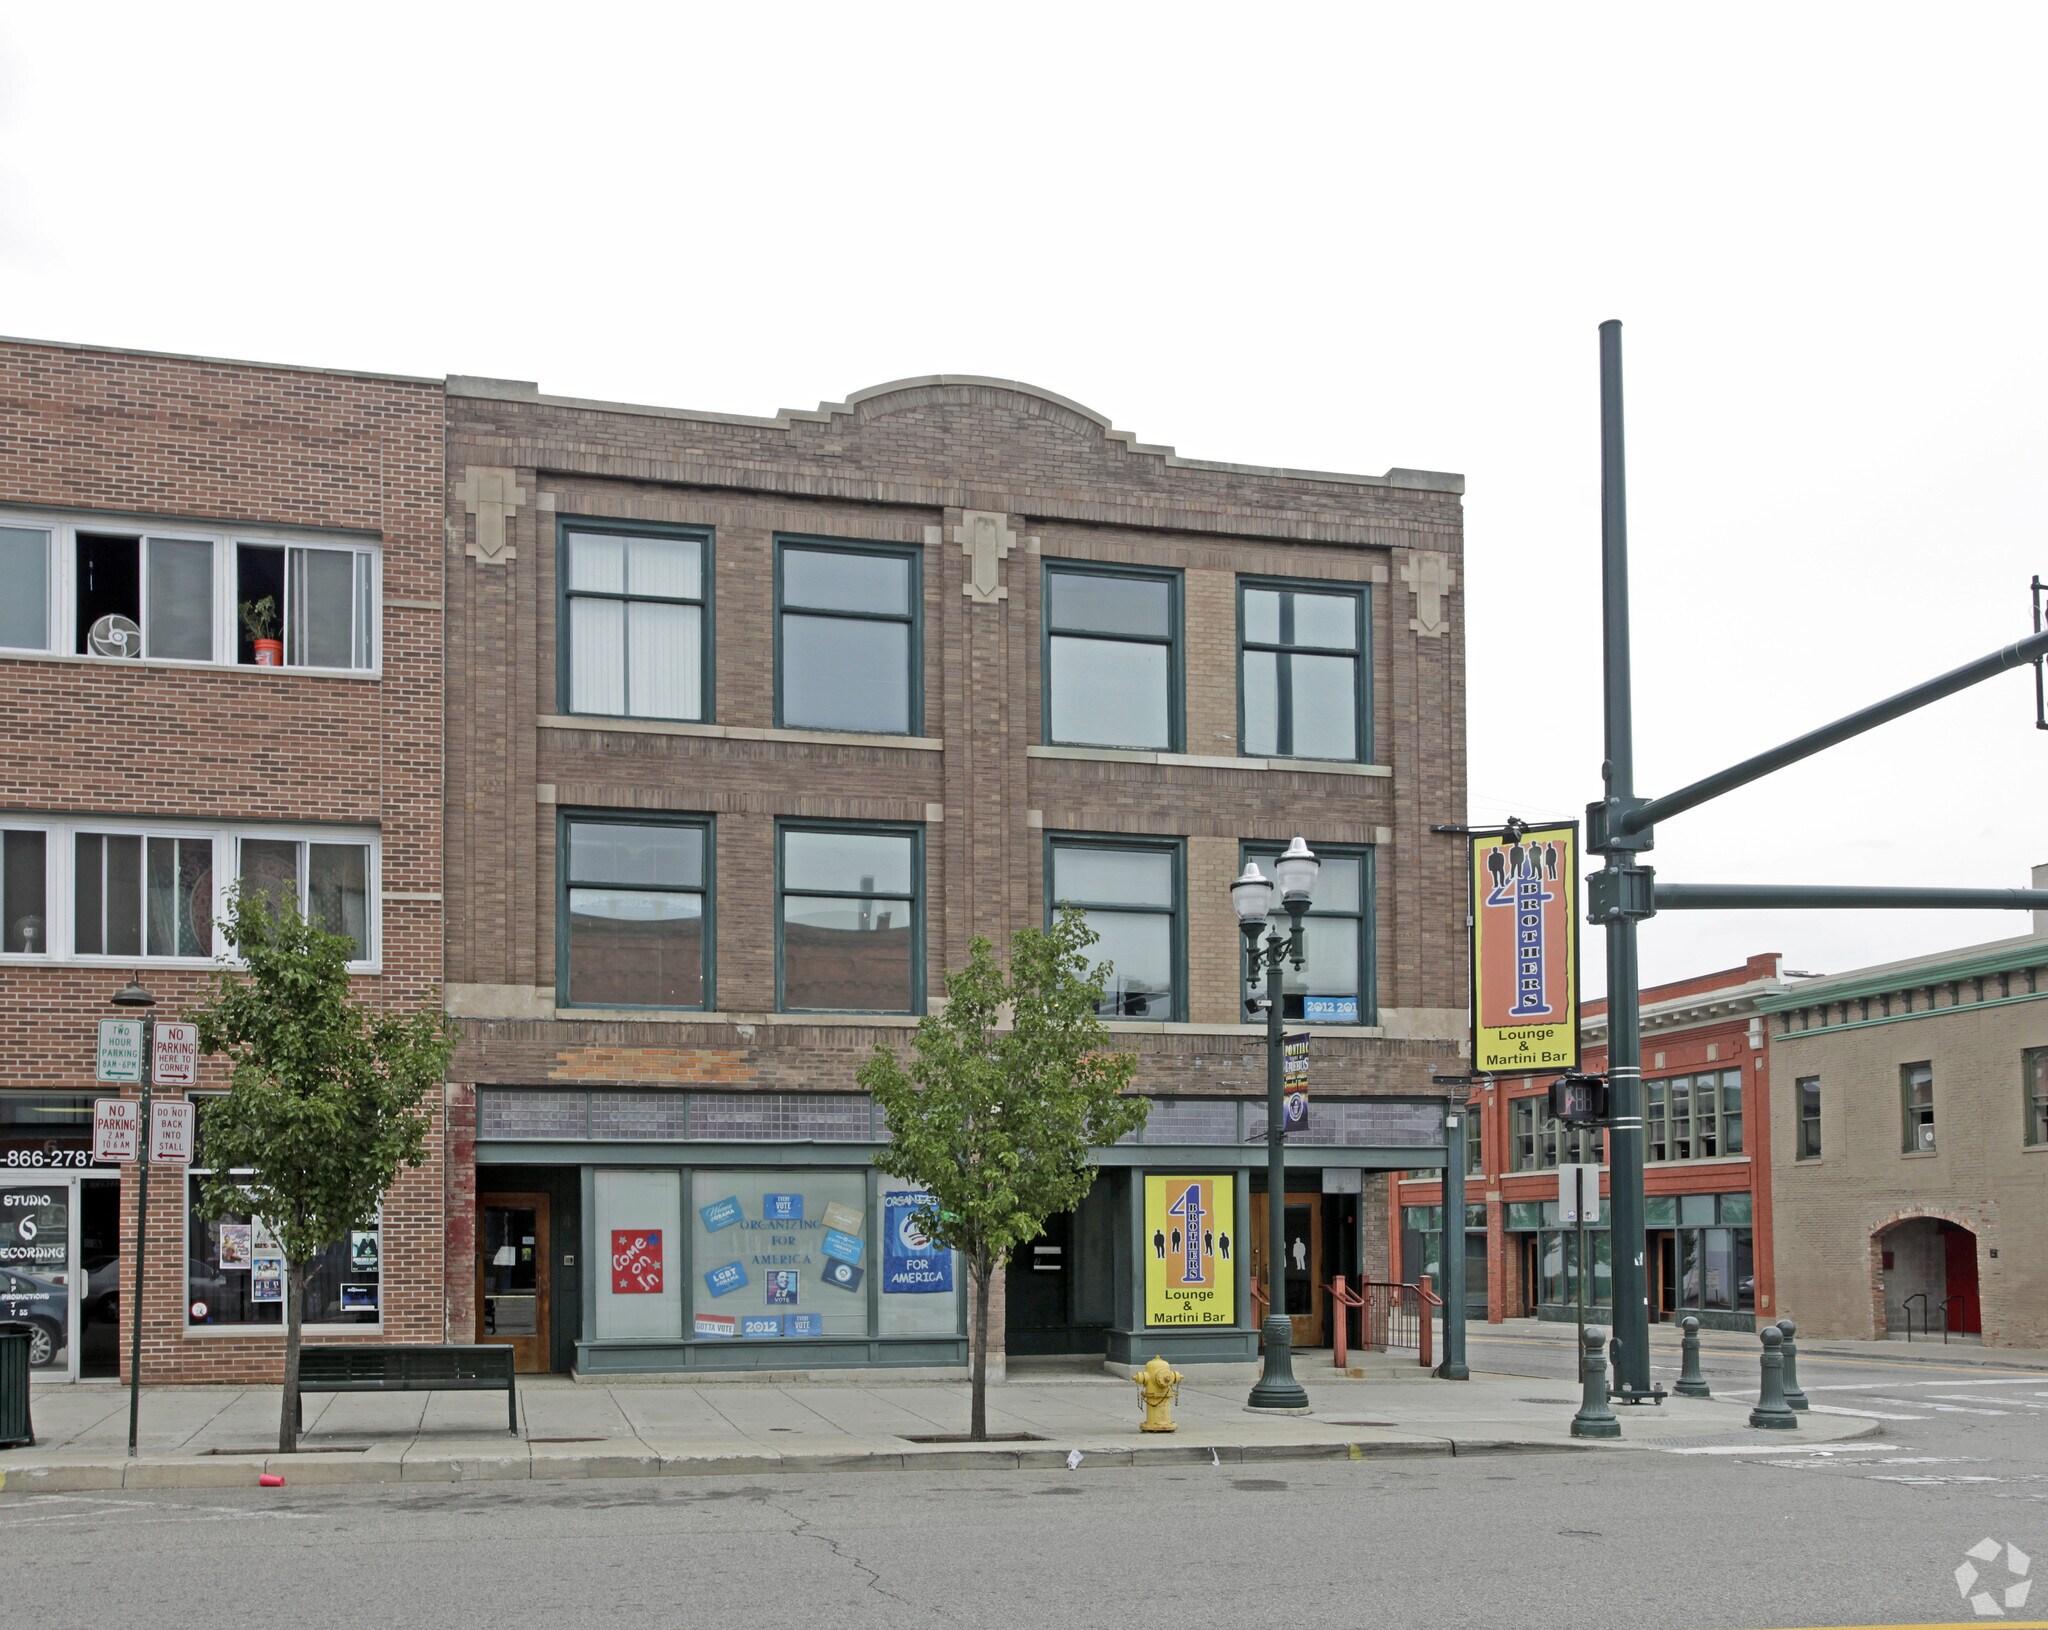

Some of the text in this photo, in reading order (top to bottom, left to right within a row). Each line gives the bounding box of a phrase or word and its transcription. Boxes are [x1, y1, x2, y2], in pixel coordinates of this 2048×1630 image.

[1485, 852, 1554, 1016] 4
[1520, 882, 1540, 1008] BROTHERS
[1307, 1001, 1358, 1013] 2012 201
[113, 1026, 130, 1035] TWO
[168, 1029, 184, 1041] NO
[1498, 1028, 1555, 1042] Lounge
[109, 1037, 132, 1046] HOUR
[1519, 1040, 1530, 1051] &
[102, 1048, 138, 1058] PARKING
[157, 1042, 194, 1055] PARKING
[1285, 1041, 1309, 1057] PONTIAC
[102, 1059, 137, 1069] 8AM-6PM
[159, 1054, 191, 1064] HERE TO
[1486, 1052, 1568, 1066] Martini Bar
[159, 1063, 190, 1072] CORNER
[109, 1105, 125, 1117] NO
[157, 1108, 187, 1117] DO NOT
[97, 1118, 136, 1131] PARKING
[161, 1119, 183, 1128] BACK
[108, 1131, 125, 1140] 2 AM
[162, 1131, 181, 1140] INTO
[103, 1140, 130, 1149] TO 6 AM
[159, 1142, 184, 1151] STALL
[4, 1194, 51, 1206] STUDIO
[775, 1201, 792, 1210] VOTE
[18, 1213, 37, 1241] 6
[740, 1219, 823, 1230] ORGANIZING
[1168, 1183, 1207, 1283] 4
[772, 1236, 796, 1246] FOR
[1188, 1203, 1199, 1279] BROTHERS
[0, 1247, 65, 1259] ECORDING
[612, 1237, 648, 1272] Come
[631, 1254, 652, 1275] on
[752, 1255, 811, 1265] AMERICA
[906, 1259, 929, 1270] FOR
[712, 1267, 736, 1282] LGBT
[891, 1271, 944, 1284] AMERICA
[637, 1272, 660, 1291] In
[1, 1293, 50, 1301] PRODUCTIONS
[1165, 1290, 1214, 1301] Lounge
[1183, 1301, 1192, 1311] &
[1154, 1312, 1225, 1323] Martini Bar
[696, 1322, 733, 1333] GOTTA VOTE
[745, 1321, 778, 1333] 2012
[794, 1321, 811, 1329] VOTE
